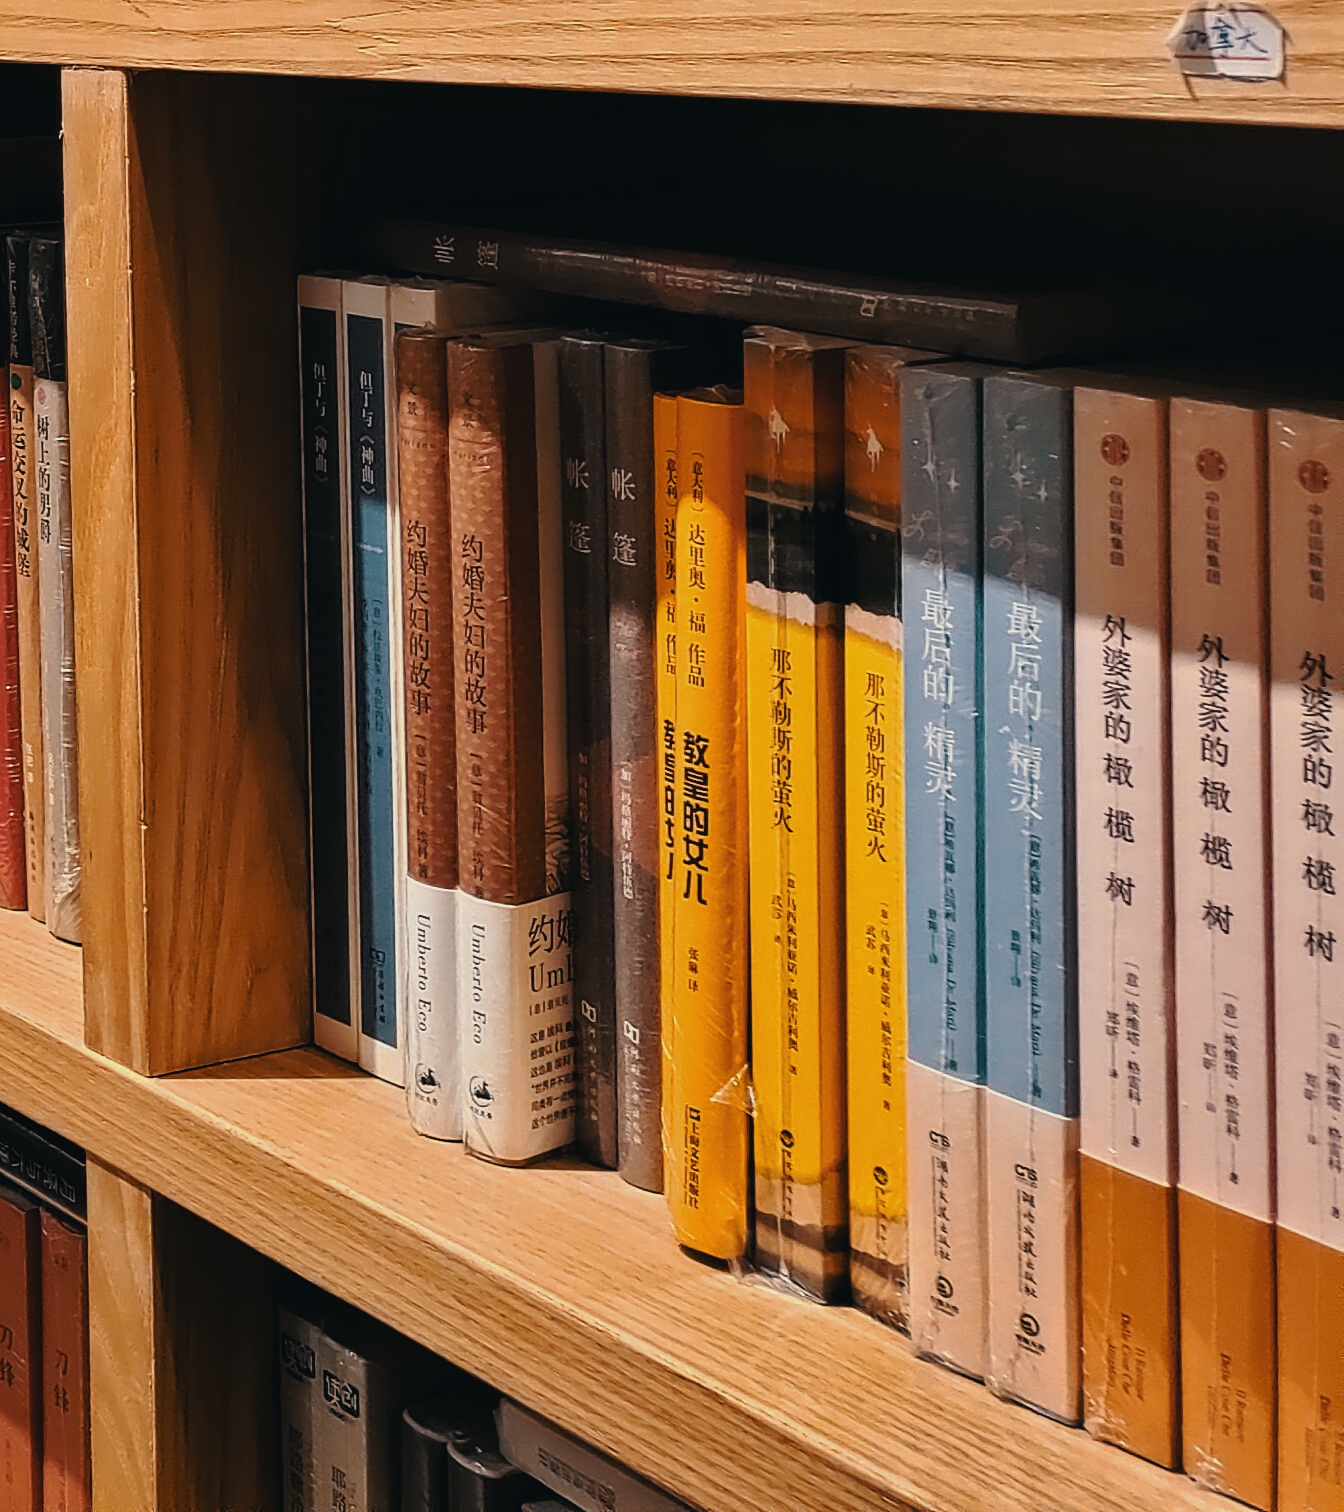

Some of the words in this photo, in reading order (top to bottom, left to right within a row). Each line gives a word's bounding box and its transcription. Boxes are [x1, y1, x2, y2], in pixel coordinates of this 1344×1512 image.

[11, 399, 31, 578] 命运交叉的城堡
[36, 412, 52, 546] 树上的男爵
[357, 369, 377, 497] 但丁与《神曲》
[689, 451, 704, 513] （意大利）
[566, 456, 593, 555] 帐篷
[611, 466, 637, 568] 帐篷
[406, 519, 433, 717] 约婚夫妇的故事
[460, 533, 489, 735] 约婚夫妇的故事
[686, 522, 707, 635] 达里奥·福
[686, 642, 707, 688] 作品
[920, 588, 957, 803] 最后的精灵
[1005, 600, 1044, 822] 最后的精灵
[769, 647, 794, 834] 那不勒斯的萤火
[863, 672, 888, 864] 那不勒斯的萤火
[1100, 612, 1136, 907] 外婆家的橄榄树
[1196, 632, 1235, 936] 外婆家的橄榄树
[1297, 648, 1336, 964] 外婆家的橄榄树
[681, 731, 710, 906] 教皇的女儿
[416, 913, 433, 993] Umberto
[417, 1000, 430, 1033] Eco
[471, 923, 486, 1005] Umberto
[473, 1012, 485, 1046] Eco
[0, 1322, 16, 1388] 刀锋
[53, 1347, 70, 1413] 刀锋
